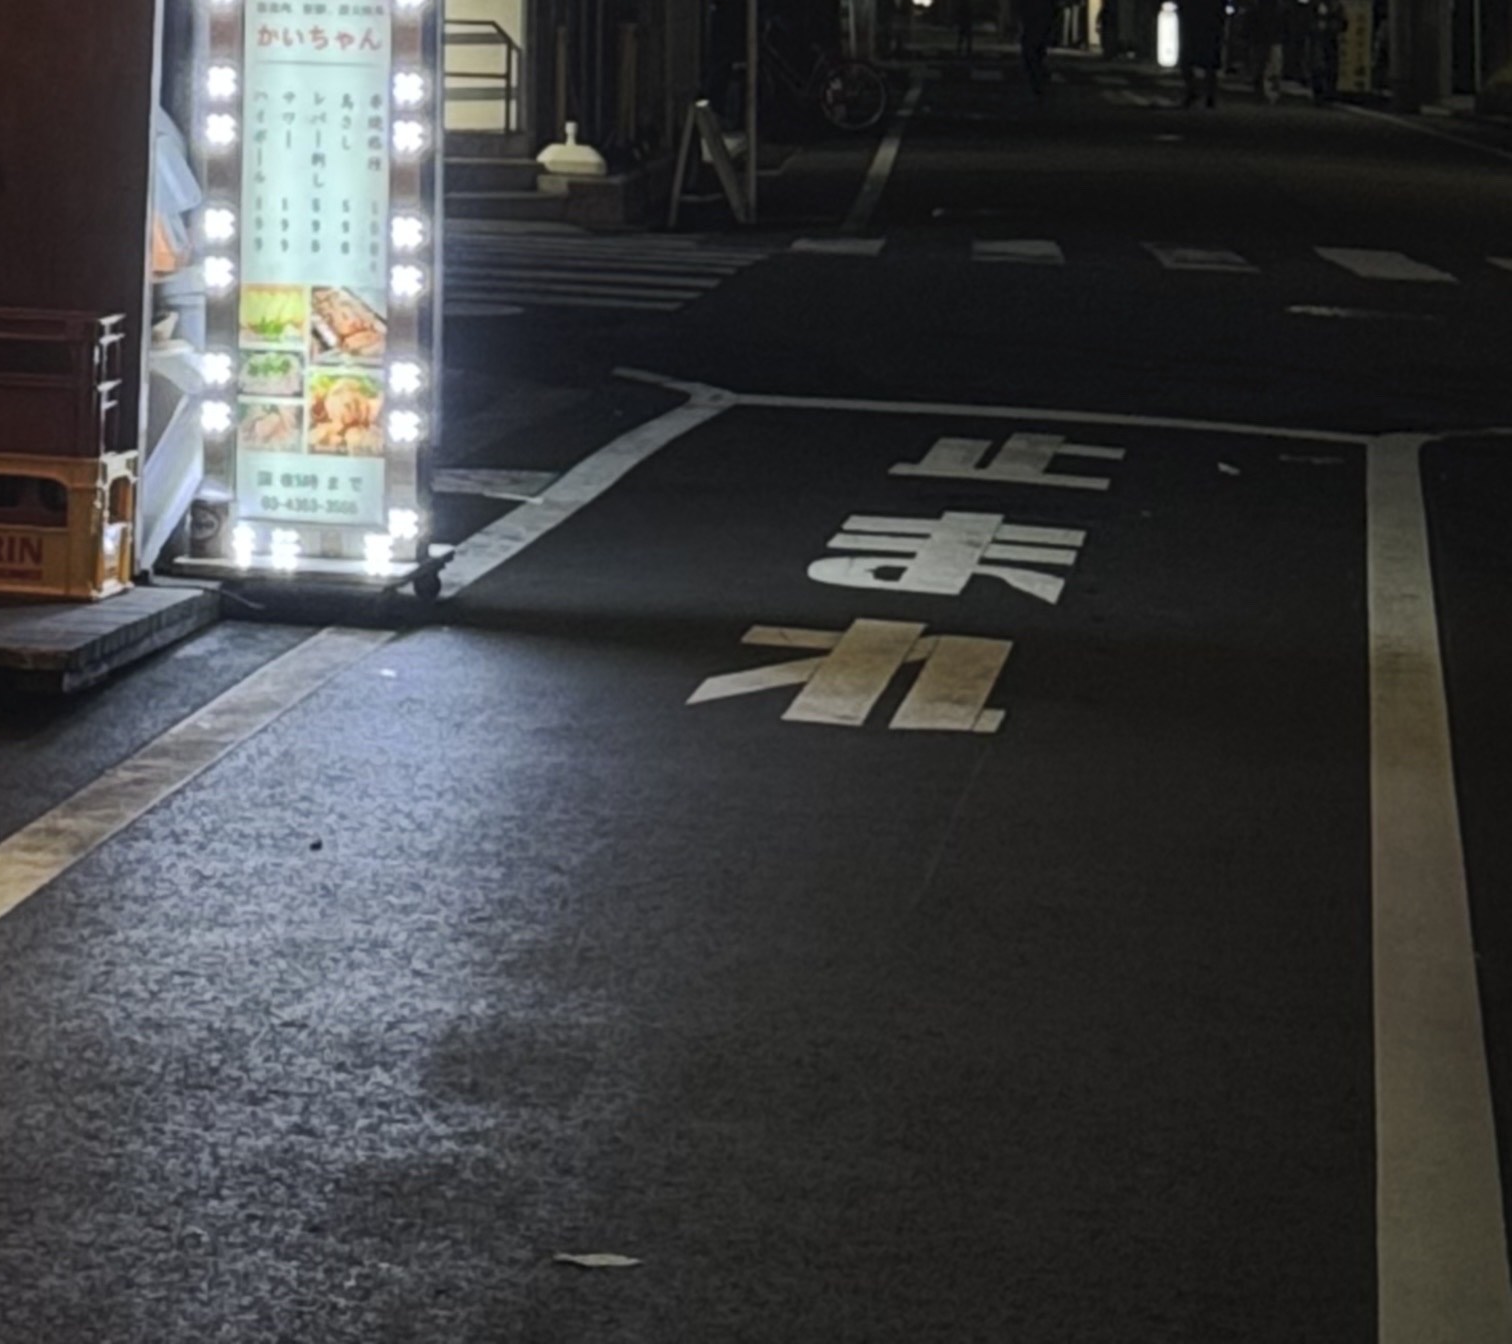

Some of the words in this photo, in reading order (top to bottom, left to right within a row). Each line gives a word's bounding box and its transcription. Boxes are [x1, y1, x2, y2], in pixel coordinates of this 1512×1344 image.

[256, 24, 383, 50] かいちゃん
[686, 432, 1128, 734] 止まれ
